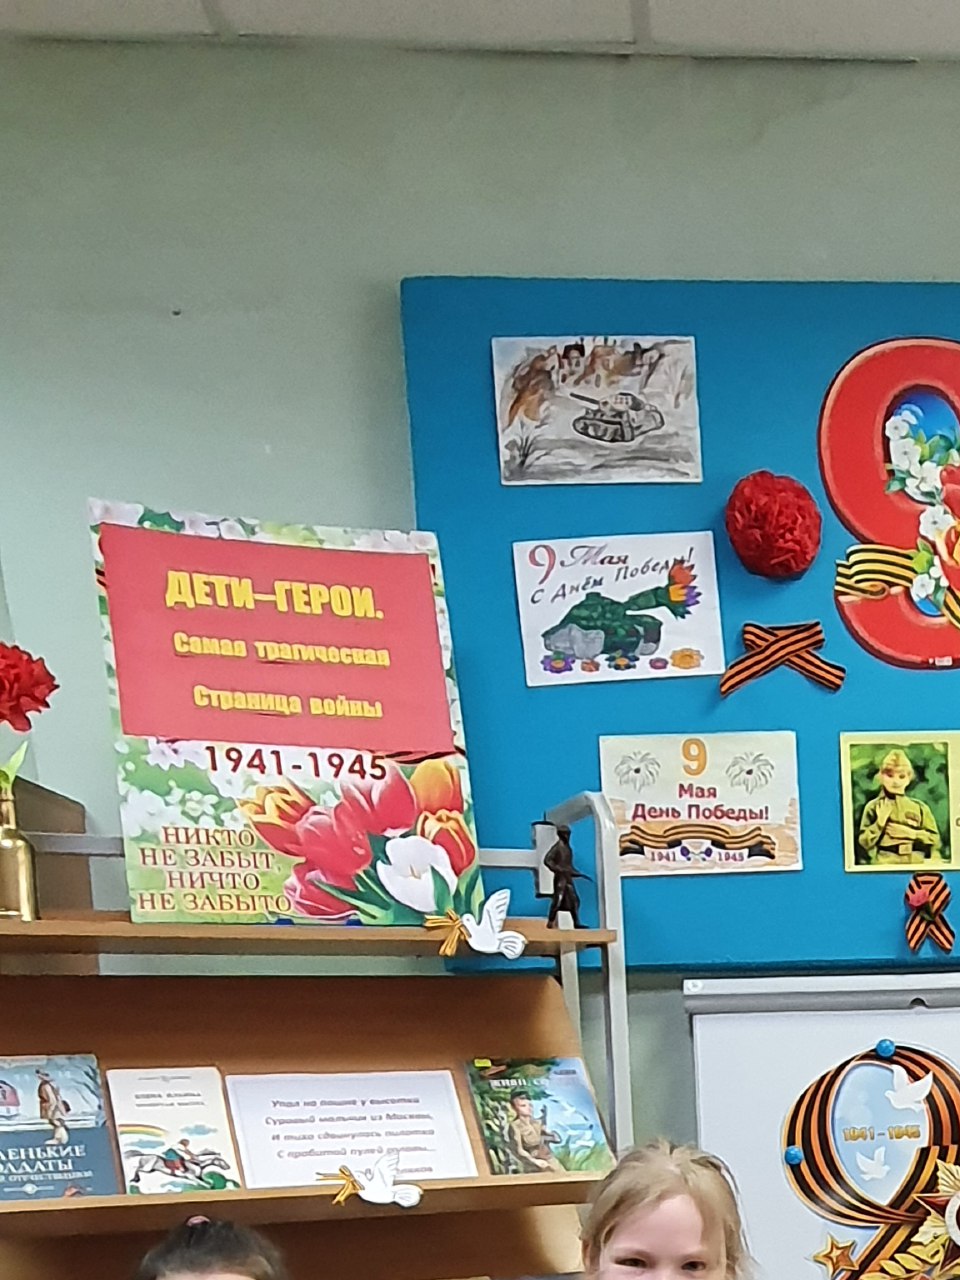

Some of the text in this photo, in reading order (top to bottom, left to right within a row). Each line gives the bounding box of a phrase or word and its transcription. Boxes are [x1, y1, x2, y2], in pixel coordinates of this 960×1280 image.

[529, 544, 629, 585] 9 Мая
[174, 632, 390, 666] Самая трагическая
[193, 685, 382, 718] Страница войны
[206, 746, 386, 779] 1941-1945
[682, 737, 707, 776] 9
[678, 783, 717, 799] Мая
[632, 803, 769, 821] День Победы!
[162, 826, 255, 846] НИКТО
[140, 848, 174, 866] НЕ
[168, 870, 260, 890] НИЧТО
[139, 893, 292, 911] НЕ ЗАБЫТО
